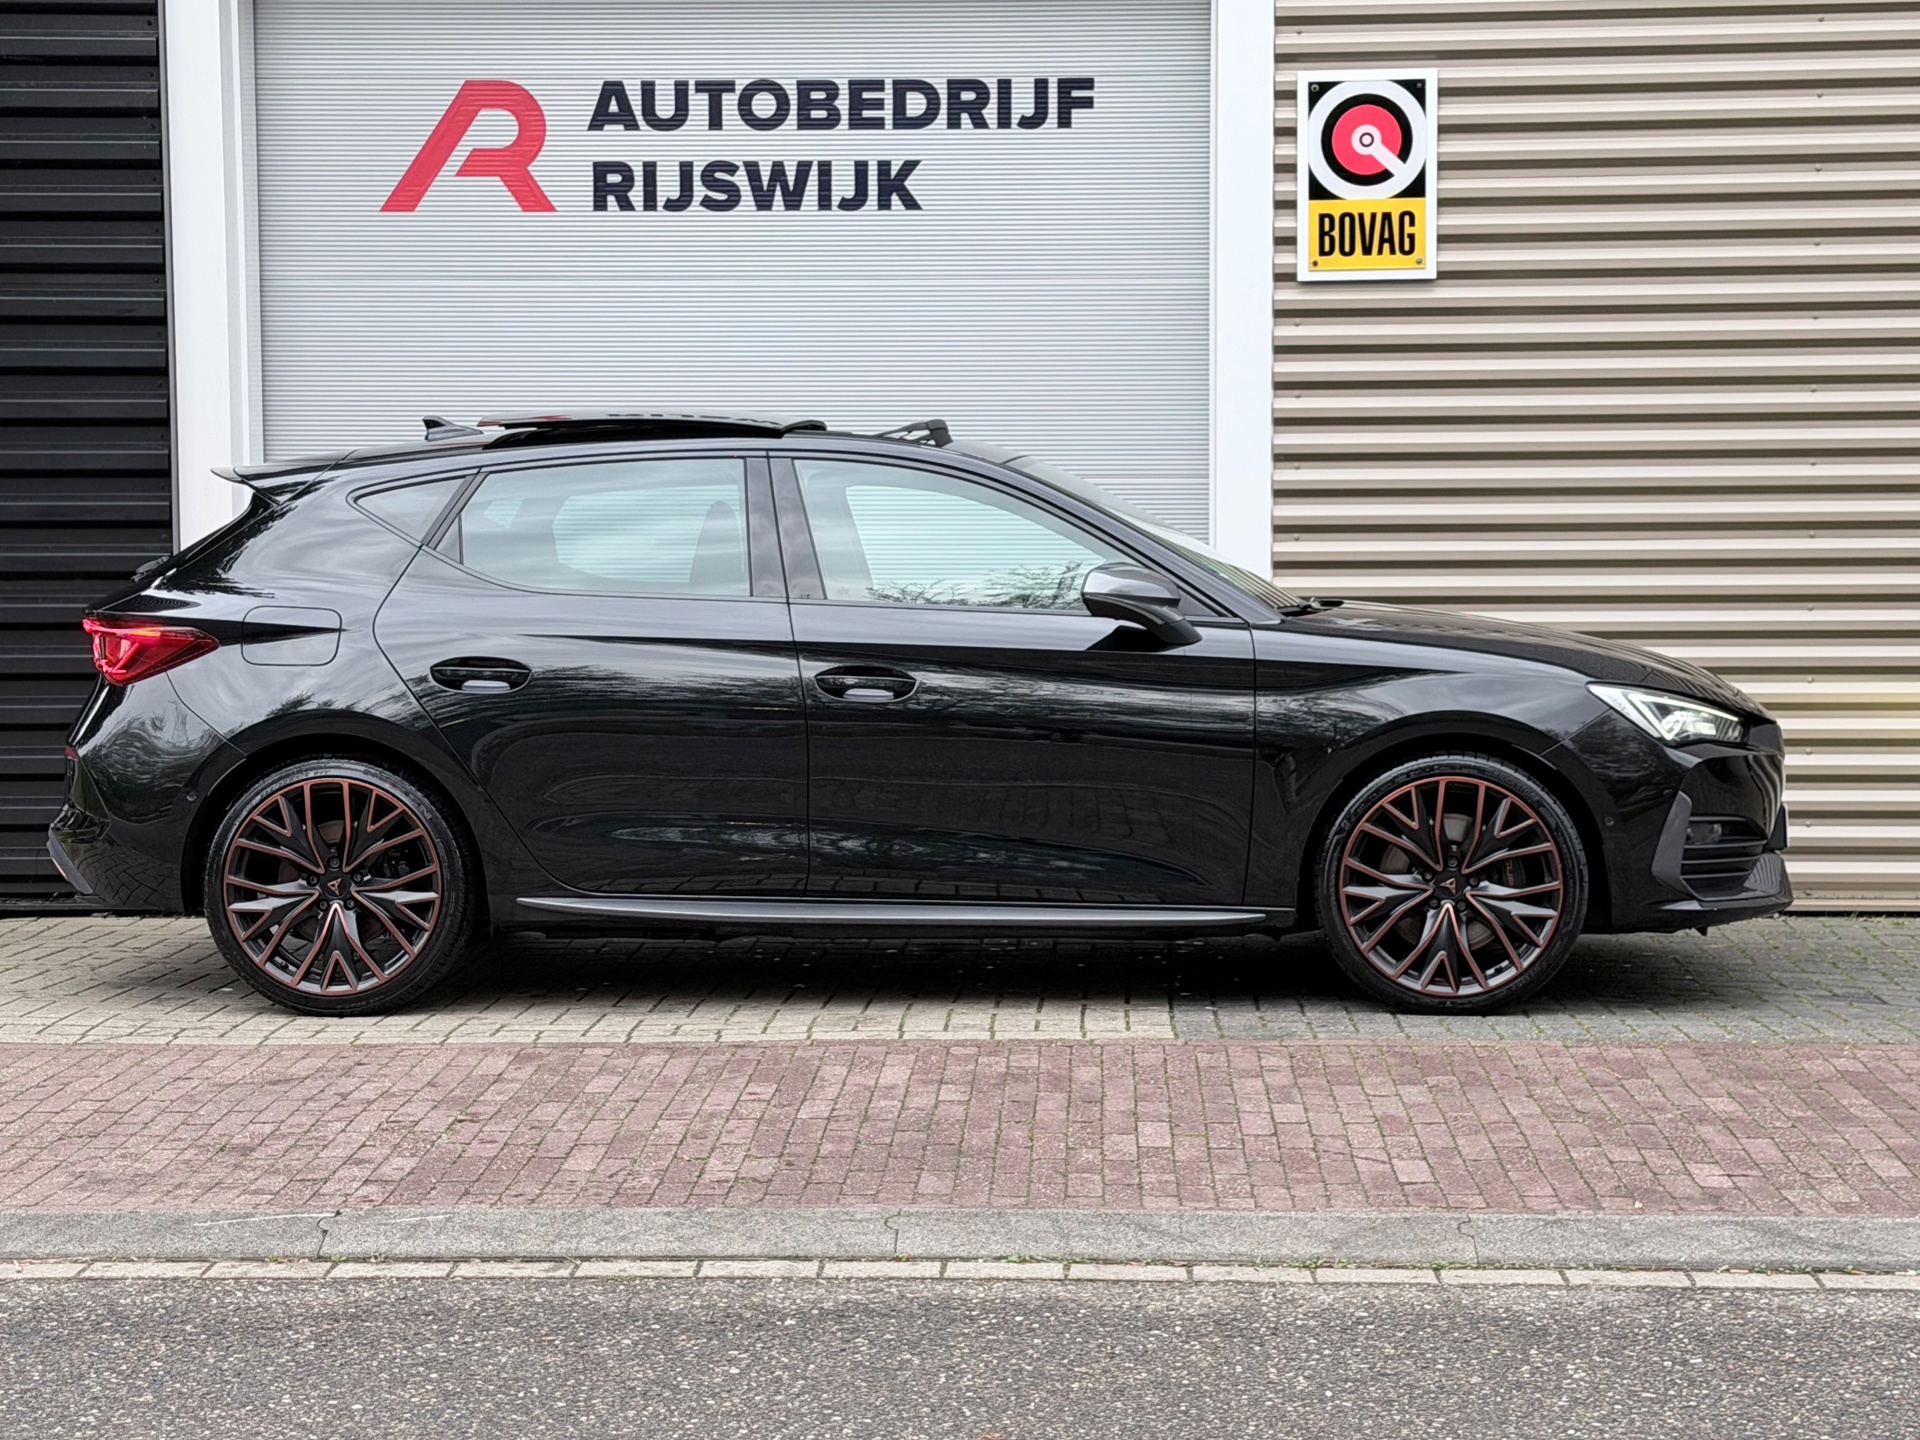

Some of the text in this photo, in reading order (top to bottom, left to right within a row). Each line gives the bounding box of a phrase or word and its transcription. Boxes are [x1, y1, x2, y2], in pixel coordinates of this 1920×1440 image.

[587, 77, 1095, 132] AUTOBEDRIJF
[592, 159, 922, 212] RIJSWIJK
[1318, 210, 1416, 257] BOVAG
